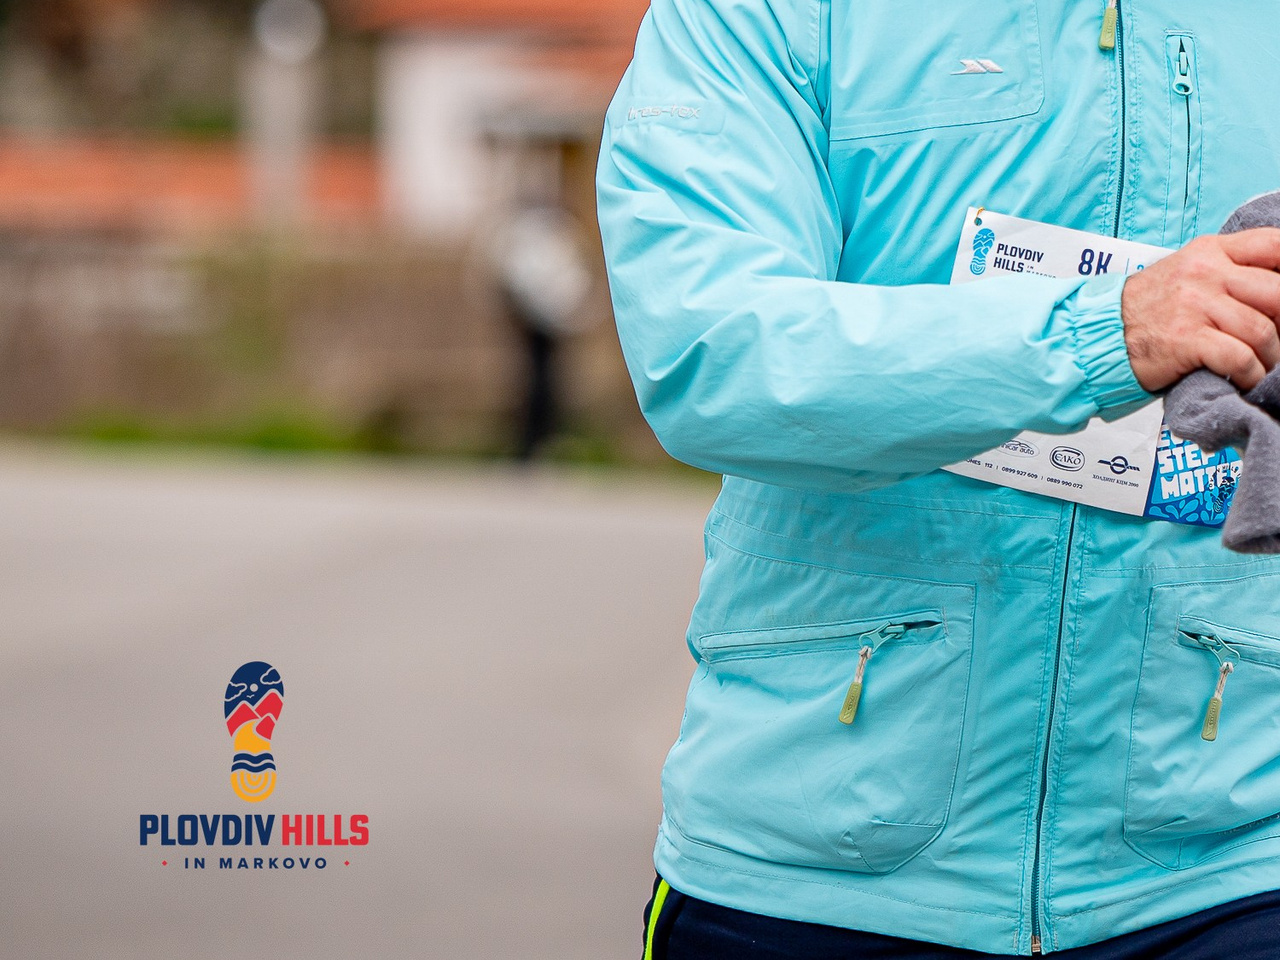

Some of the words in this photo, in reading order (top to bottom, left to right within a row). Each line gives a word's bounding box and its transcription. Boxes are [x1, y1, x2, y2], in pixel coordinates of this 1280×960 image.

[996, 243, 1044, 263] PLOVDIV
[1077, 248, 1113, 276] 8K
[993, 256, 1025, 273] HILLS
